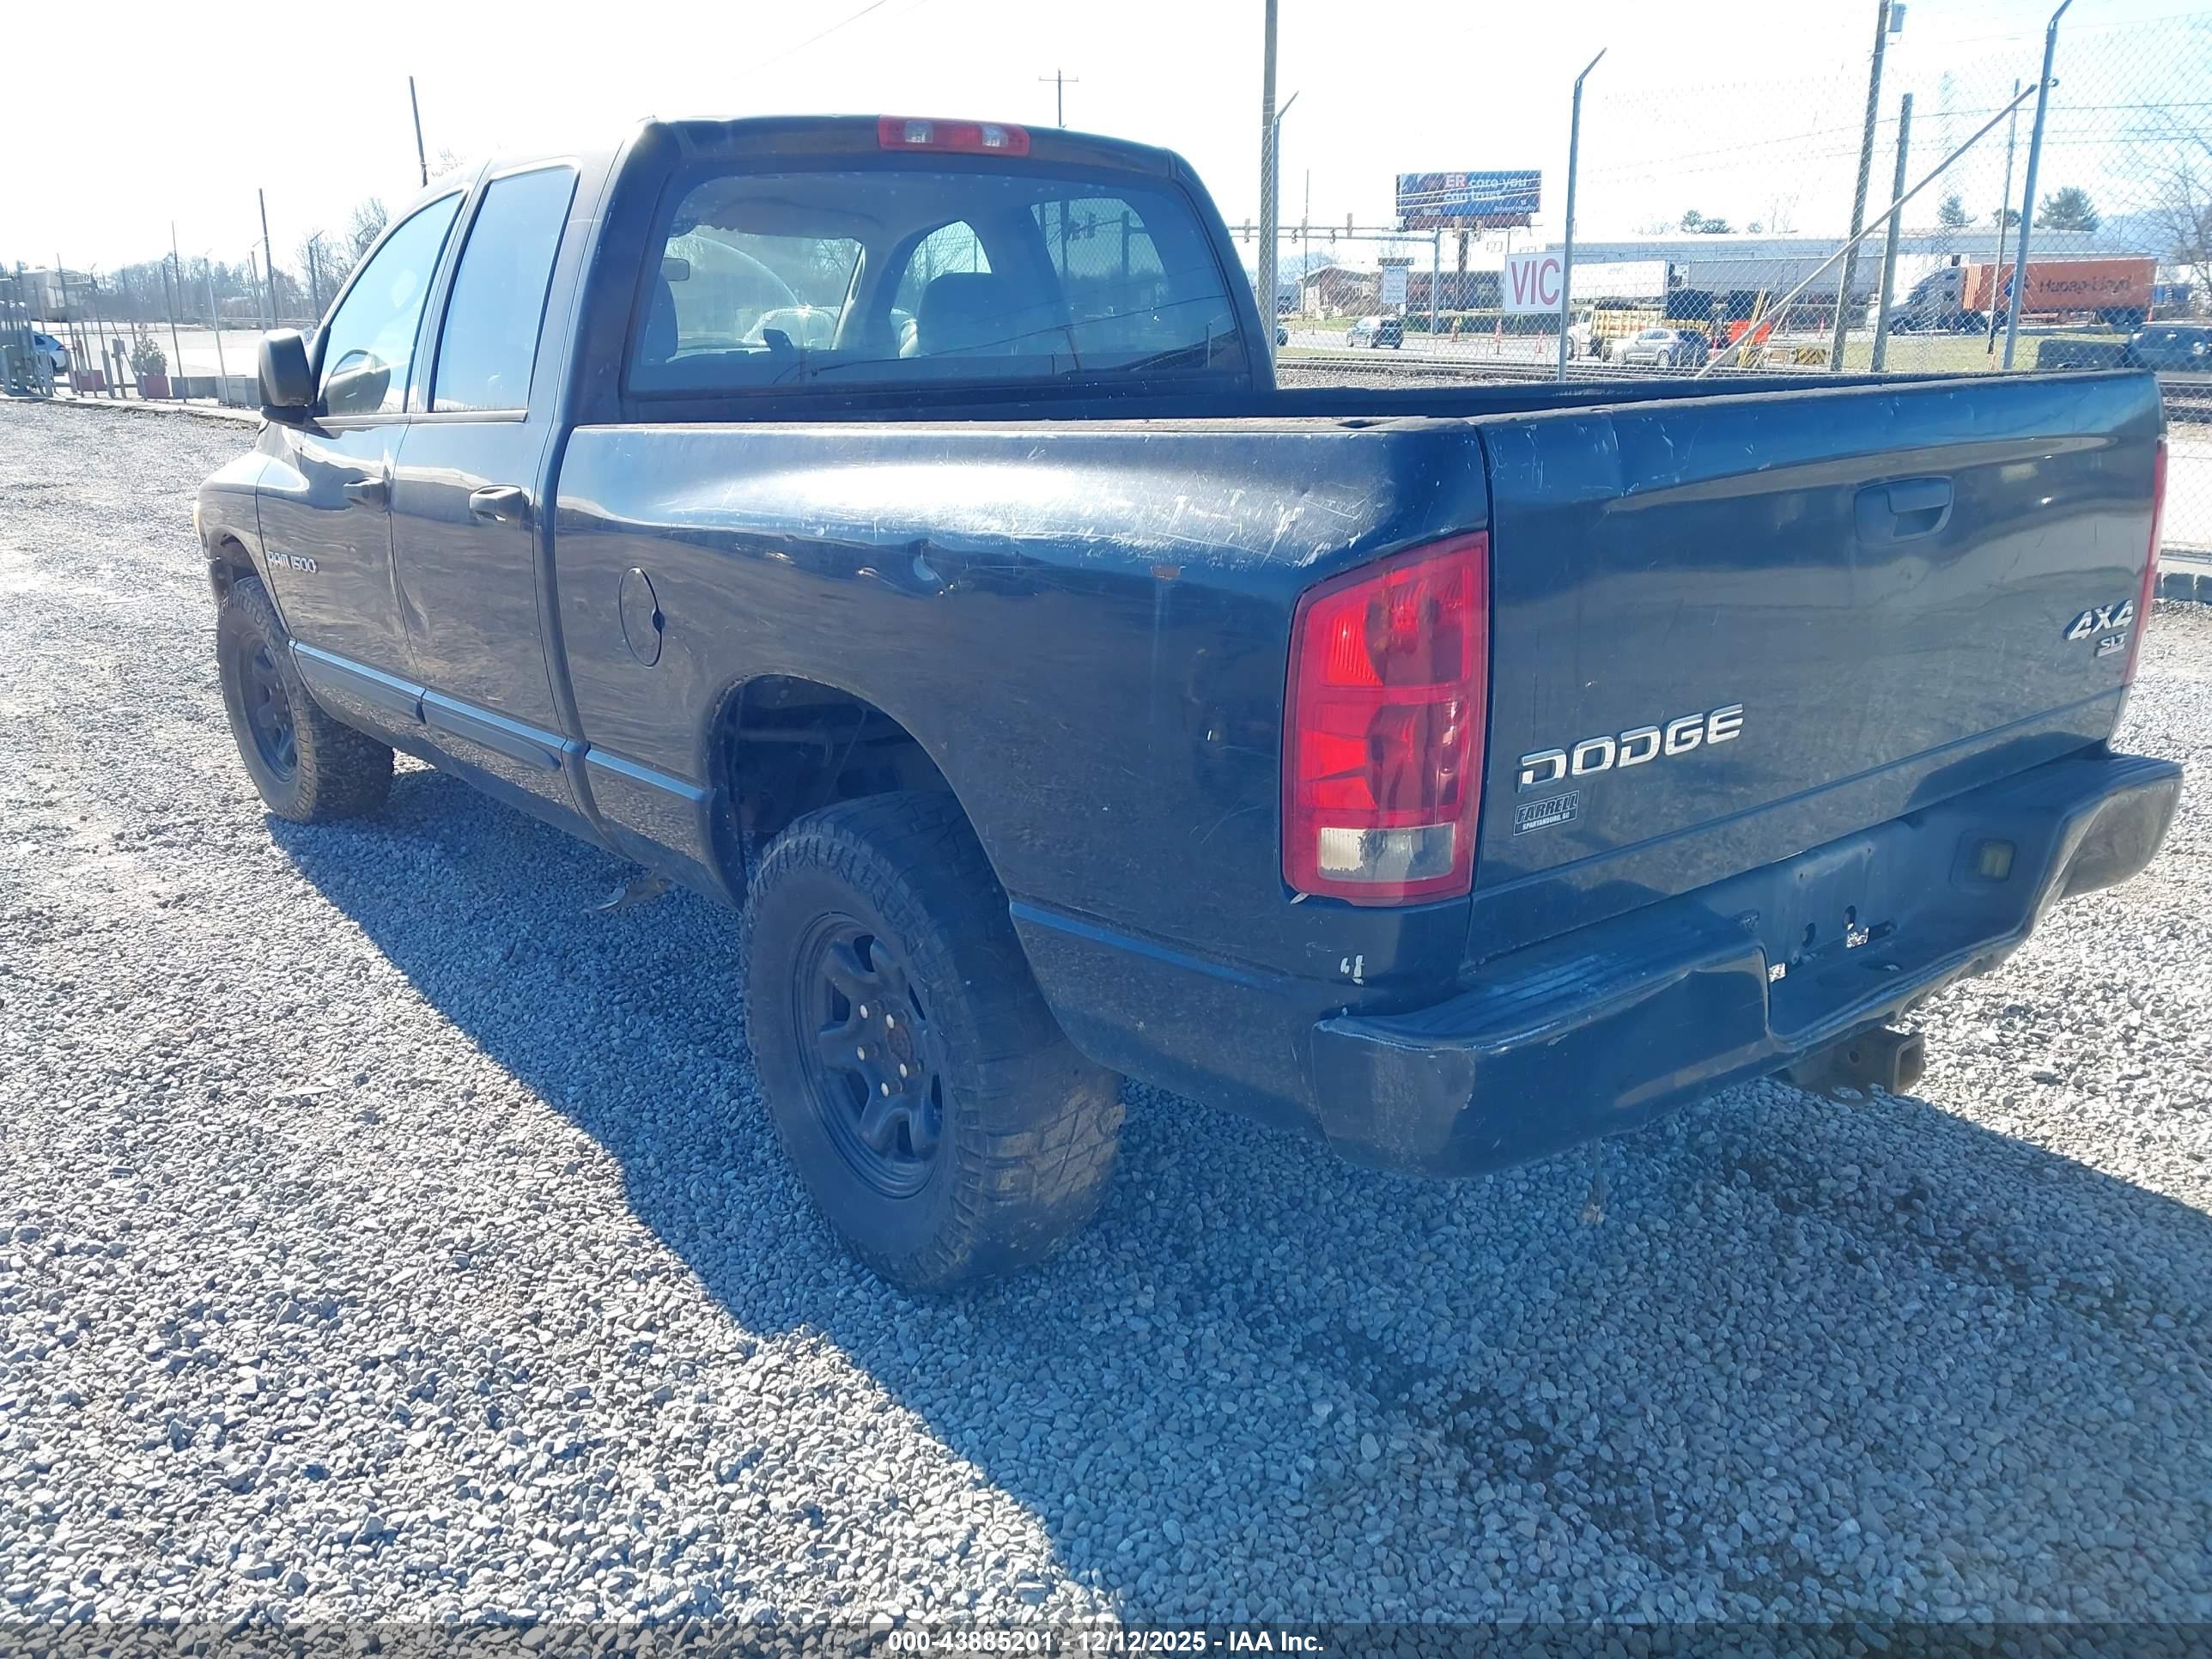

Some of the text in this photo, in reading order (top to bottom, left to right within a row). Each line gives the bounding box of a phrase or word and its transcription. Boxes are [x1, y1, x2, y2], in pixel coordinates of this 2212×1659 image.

[1445, 174, 1527, 190] ER care you
[1443, 191, 1468, 202] can
[1510, 258, 1560, 306] VIC
[267, 551, 317, 573] RAM 1500
[2097, 632, 2127, 649] SLT
[1517, 703, 1744, 793] DODGE
[1516, 793, 1577, 824] FARRELL
